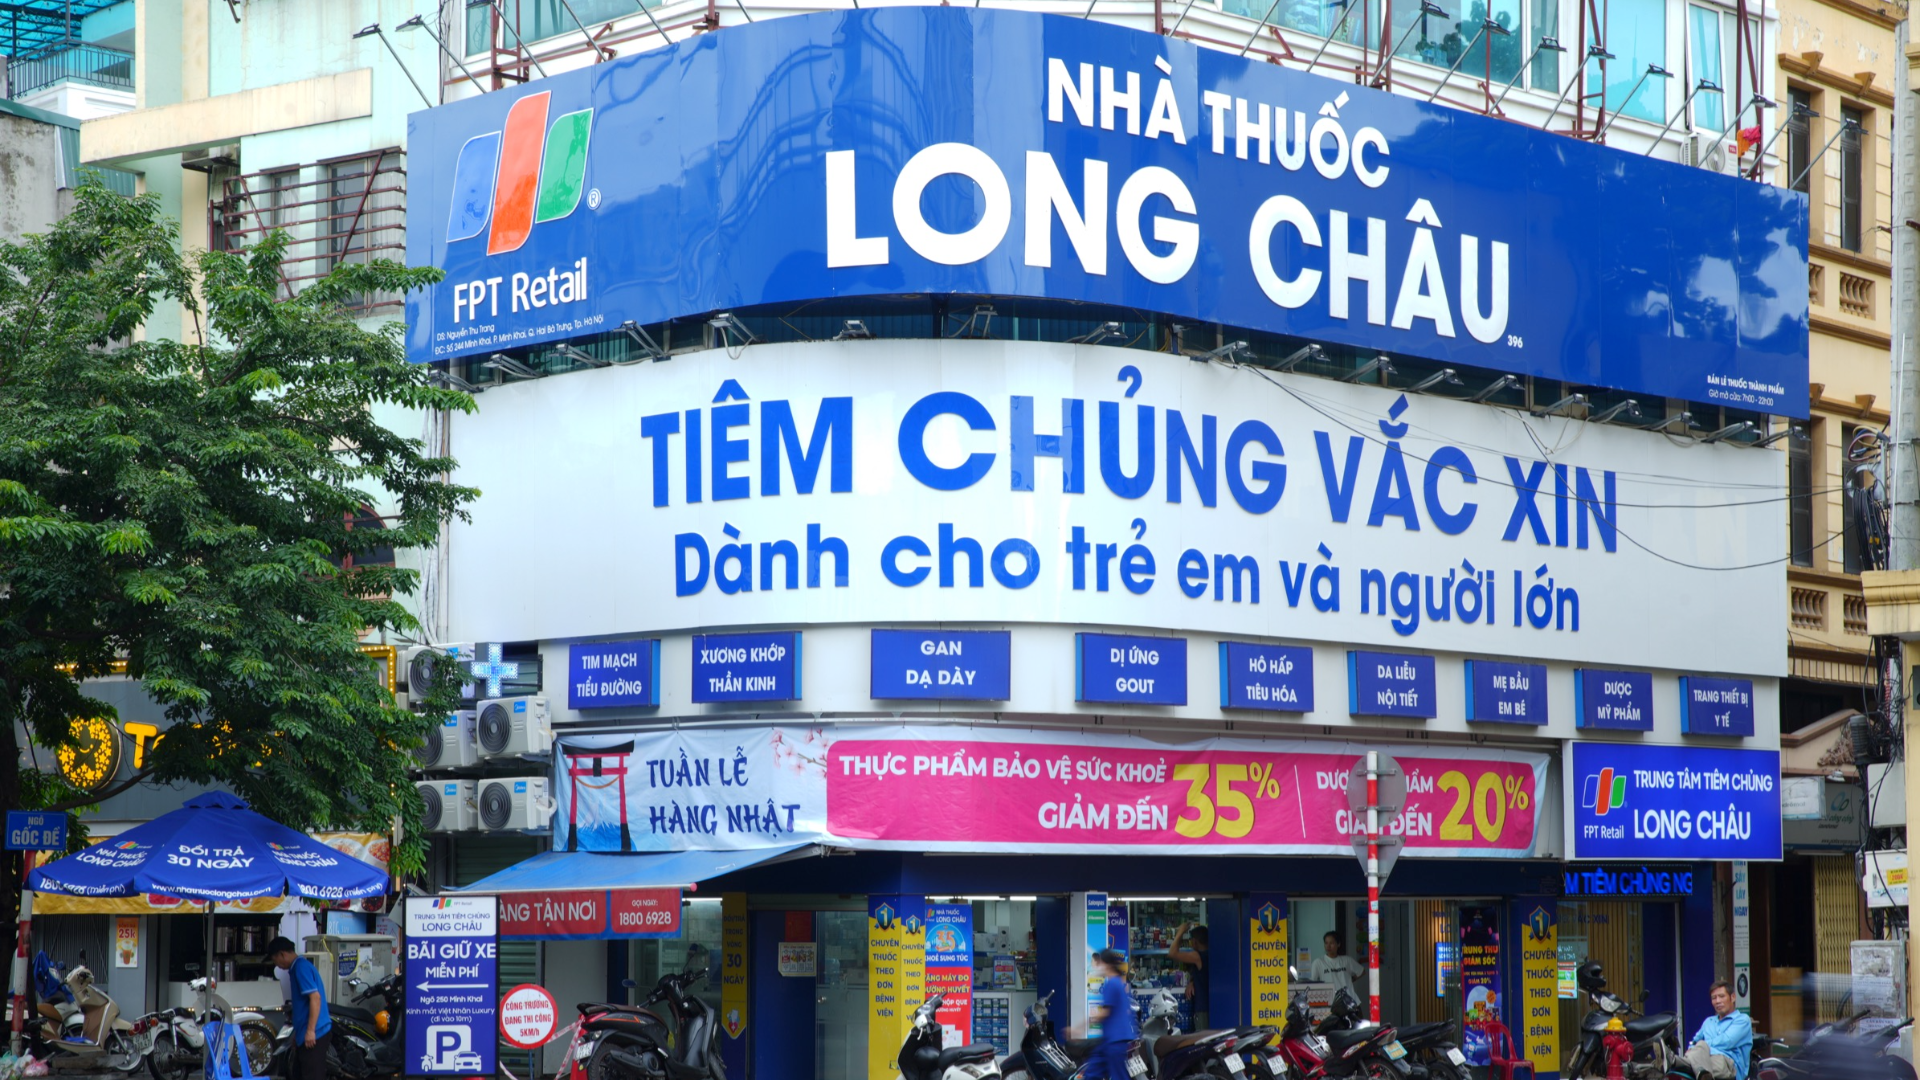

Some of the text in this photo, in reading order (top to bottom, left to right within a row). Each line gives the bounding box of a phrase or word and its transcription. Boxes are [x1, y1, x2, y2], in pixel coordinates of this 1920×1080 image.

[1048, 56, 1390, 188] NHÀ THUỐC
[825, 142, 1510, 344] LONG CHÂU
[454, 257, 587, 323] FPT Retail
[447, 327, 468, 340] Nguyễn
[469, 326, 479, 335] Thu
[479, 324, 495, 333] Trang
[1507, 334, 1524, 348] 396
[1707, 374, 1719, 385] BÁN
[1727, 377, 1747, 389] THUỐC
[1748, 380, 1767, 392] THÀNH
[1768, 382, 1784, 395] PHẨM
[641, 365, 1617, 554] TIÊM CHỦNG VẮC XIN
[675, 518, 1580, 637] Dành cho trẻ em và người lớn
[701, 644, 786, 665] XƯƠNG KHỚP
[920, 641, 962, 656] GAN
[1110, 644, 1159, 667] DỊ ỨNG
[582, 653, 637, 671] TIM MẠCH
[1249, 653, 1293, 675] HÔ HẤP
[906, 667, 976, 689] DẠ DÀY
[1377, 662, 1416, 681] DA LIỄU
[576, 676, 642, 698] TIỂU ĐƯỜNG
[710, 671, 776, 693] THẦN KINH
[1116, 678, 1154, 694] GOUT
[1493, 671, 1529, 693] MẸ BẦU
[1604, 680, 1632, 697] DƯỢC
[1247, 682, 1298, 703] TIÊU HÓA
[1377, 687, 1418, 708] NỘI TIẾT
[1693, 687, 1749, 707] TRANG THIẾT BỊ
[1499, 698, 1526, 716] EM BÉ
[1597, 700, 1641, 722] MỸ PHẨM
[1715, 710, 1730, 728] Y TẾ
[647, 745, 749, 788] TUẦN LỄ
[839, 749, 1166, 784] THỰC PHẨM BẢO VỆ SỨC KHOẺ
[1633, 767, 1773, 792] TRUNG TÂM TIÊM CHỦNG
[1173, 762, 1280, 839] 35%
[1437, 769, 1529, 842] 20%
[649, 798, 801, 838] HÀNG NHẬT
[1038, 793, 1168, 830] GIẢM ĐẾN
[28, 815, 44, 825] NGÕ
[1634, 803, 1750, 840] LONG CHÂU
[12, 825, 60, 845] GỐC ĐỀ
[1584, 825, 1624, 839] FPT Retail
[179, 844, 245, 857] ĐỔI TRẢ
[167, 854, 255, 869] 30 NGÀY
[1581, 867, 1616, 894] TIÊM
[1620, 866, 1671, 894] CHỦNG
[1673, 872, 1692, 894] NG
[437, 911, 450, 919] TÂM
[452, 911, 466, 919] TIÊM
[467, 911, 491, 919] CHỦNG
[500, 898, 596, 927] ÀNG TẬN NƠI
[619, 911, 672, 925] 1800 6928
[952, 915, 966, 923] CHÂU
[118, 928, 136, 938] 25k
[422, 920, 482, 932] LONG CHÂU
[408, 940, 496, 959] BÃI GIỮ XE
[870, 939, 899, 947] CHUYÊN
[1252, 939, 1286, 950] CHUYÊN
[727, 953, 742, 968] 30
[873, 951, 897, 961] THUỐC
[903, 957, 923, 965] THUỐC
[1254, 956, 1284, 967] THUỐC
[1523, 949, 1556, 960] CHUYÊN
[425, 961, 480, 978] MIỄN PHÍ
[1526, 967, 1554, 978] THUỐC
[723, 973, 745, 984] NGÀY
[877, 981, 893, 989] ĐƠN
[1258, 976, 1281, 984] THEO
[420, 996, 435, 1005] Ngõ
[875, 994, 895, 1004] BỆNH
[1260, 992, 1279, 1001] ĐƠN
[1530, 988, 1552, 998] THEO
[505, 1000, 549, 1011] CÔNG TRƯỜNG
[905, 998, 921, 1006] BỆNH
[504, 1013, 552, 1025] ĐANG THI CÔNG
[877, 1008, 894, 1018] VIỆN
[1258, 1007, 1281, 1020] BỆNH
[1532, 1005, 1550, 1017] ĐƠN
[520, 1028, 540, 1037] 5KM/h
[1530, 1024, 1553, 1038] BỆNH
[436, 1031, 462, 1064] P
[1532, 1042, 1552, 1058] VIỆN
